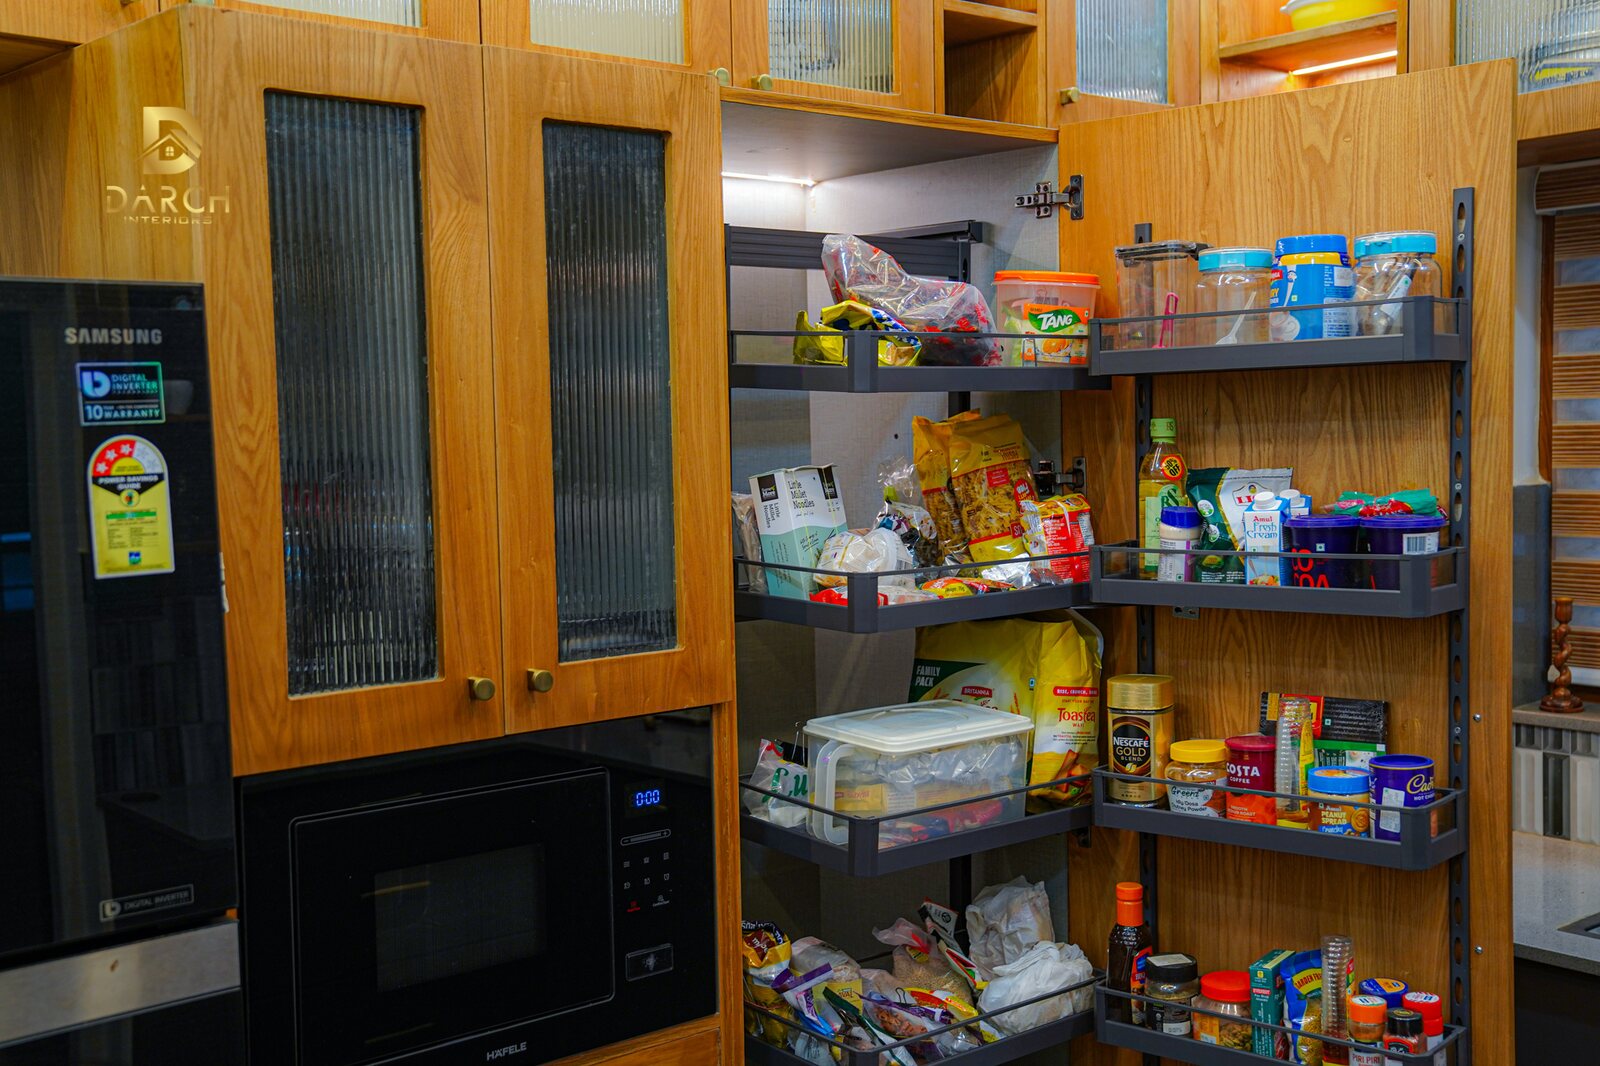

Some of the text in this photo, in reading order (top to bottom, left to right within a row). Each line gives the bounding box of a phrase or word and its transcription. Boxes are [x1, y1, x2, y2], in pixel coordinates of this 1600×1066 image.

[1037, 312, 1073, 331] TANG
[64, 327, 162, 344] SAMSUNG
[112, 373, 148, 382] DIGITAL
[112, 381, 158, 390] INVERTER
[85, 404, 103, 420] 10
[103, 408, 160, 419] WARRANTY
[1169, 463, 1181, 476] OFF
[788, 480, 802, 490] Little
[792, 499, 815, 510] Noodles
[1253, 521, 1277, 532] Fresh
[1246, 530, 1278, 539] Cream
[916, 665, 941, 677] FAMILY
[915, 675, 935, 687] PACK
[963, 687, 990, 696] BRITANNIA
[1113, 736, 1150, 748] NESCAFÉ
[1115, 746, 1147, 757] GOLD
[1226, 762, 1260, 777] COSTA
[1229, 776, 1250, 784] COFFEE
[1321, 811, 1347, 819] PEANUT
[1321, 817, 1347, 826] SPREAD
[486, 1041, 527, 1061] HÄFELE
[1352, 1053, 1380, 1064] PIRI PIRI
